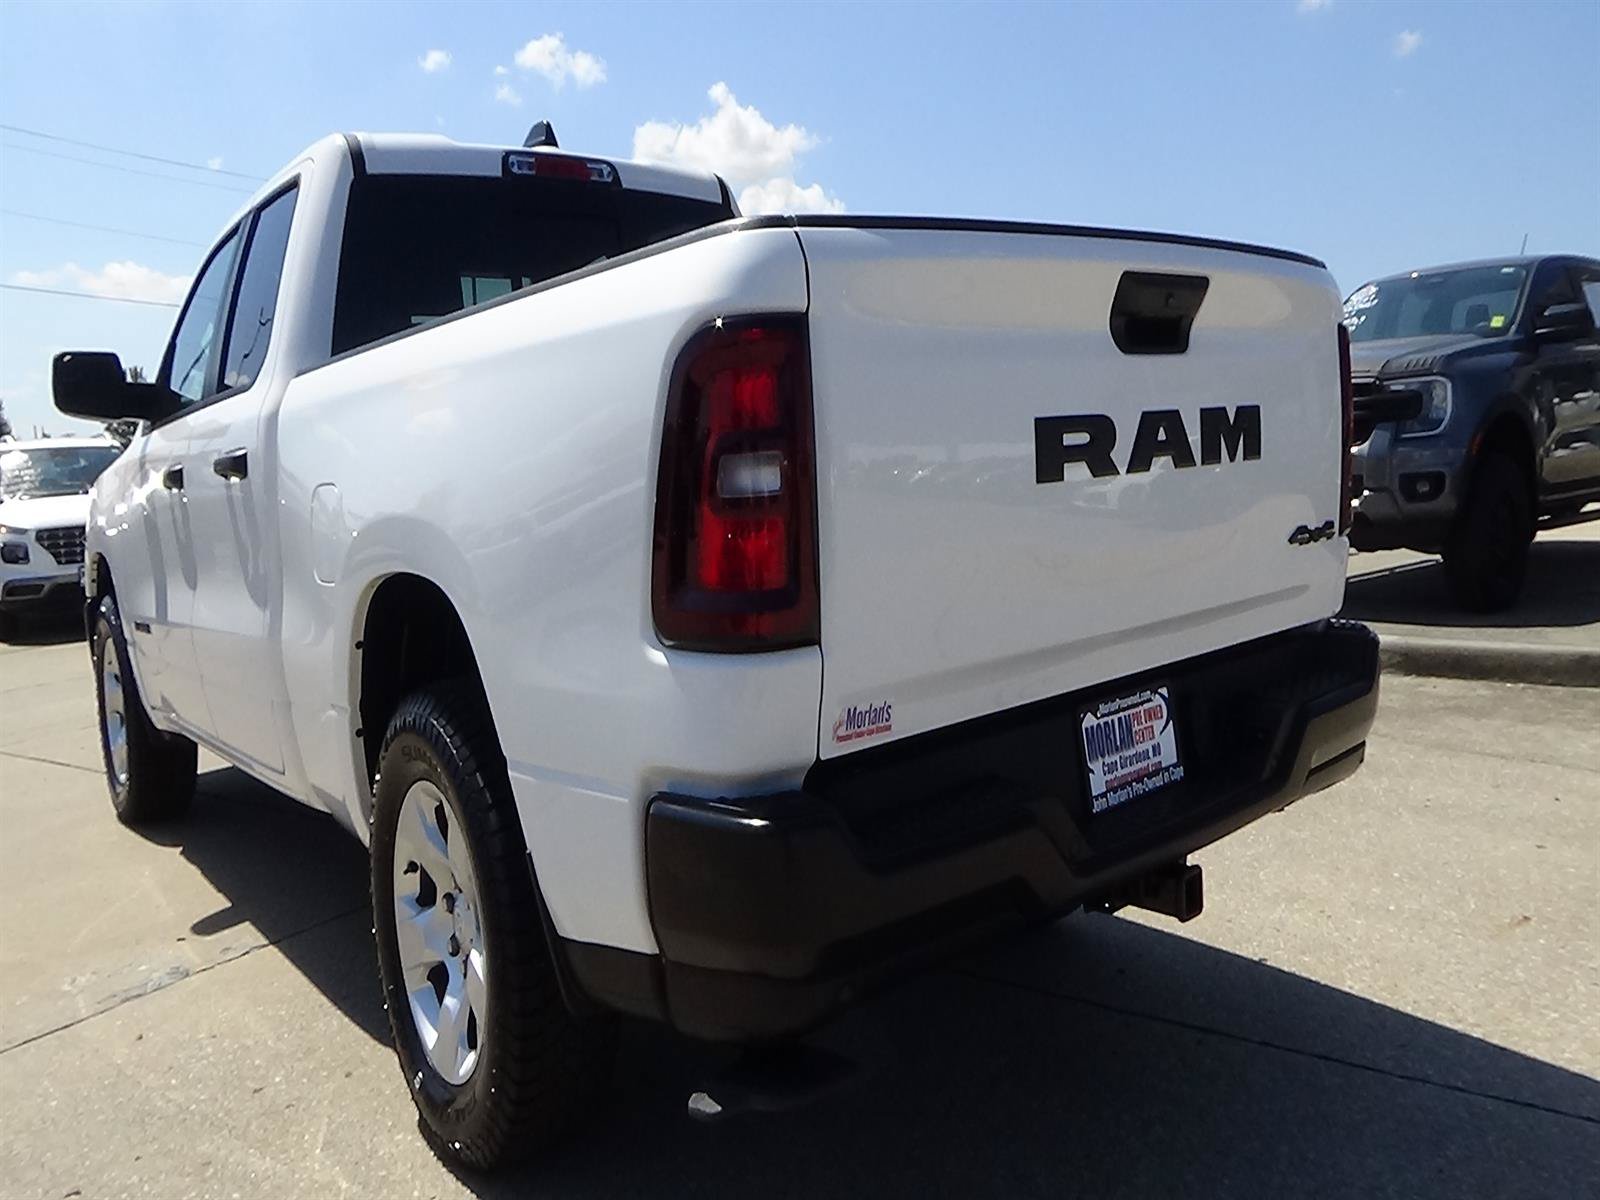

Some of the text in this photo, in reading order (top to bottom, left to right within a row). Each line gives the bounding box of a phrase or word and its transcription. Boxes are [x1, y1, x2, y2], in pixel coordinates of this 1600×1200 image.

[1034, 404, 1262, 484] RAM
[1085, 714, 1135, 762] MORLAN
[1102, 760, 1118, 776] Cape
[1151, 742, 1162, 757] MO
